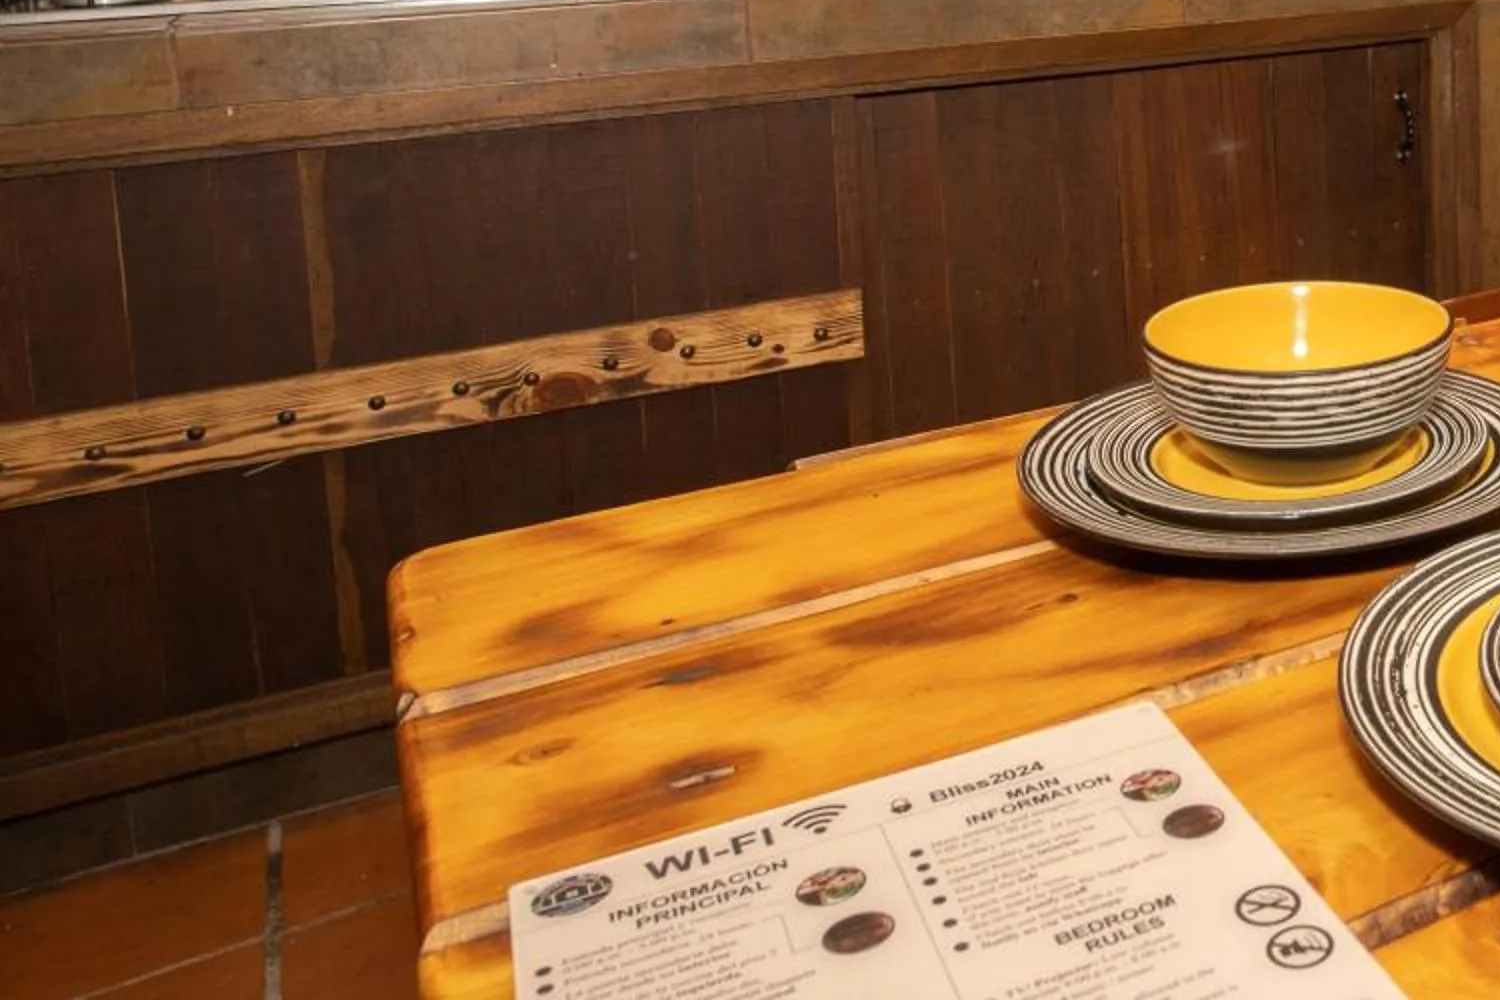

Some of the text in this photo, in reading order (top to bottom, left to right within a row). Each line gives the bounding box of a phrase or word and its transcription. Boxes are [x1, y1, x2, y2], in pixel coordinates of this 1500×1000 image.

[928, 760, 1044, 803] Bliss2024
[965, 773, 1112, 826] INFORMATION
[1005, 776, 1061, 800] MAIN
[645, 826, 775, 880] WI-FI
[636, 881, 771, 929] PRINCIPAL
[1054, 894, 1177, 946] BEDROOM
[1084, 916, 1166, 953] RULES
